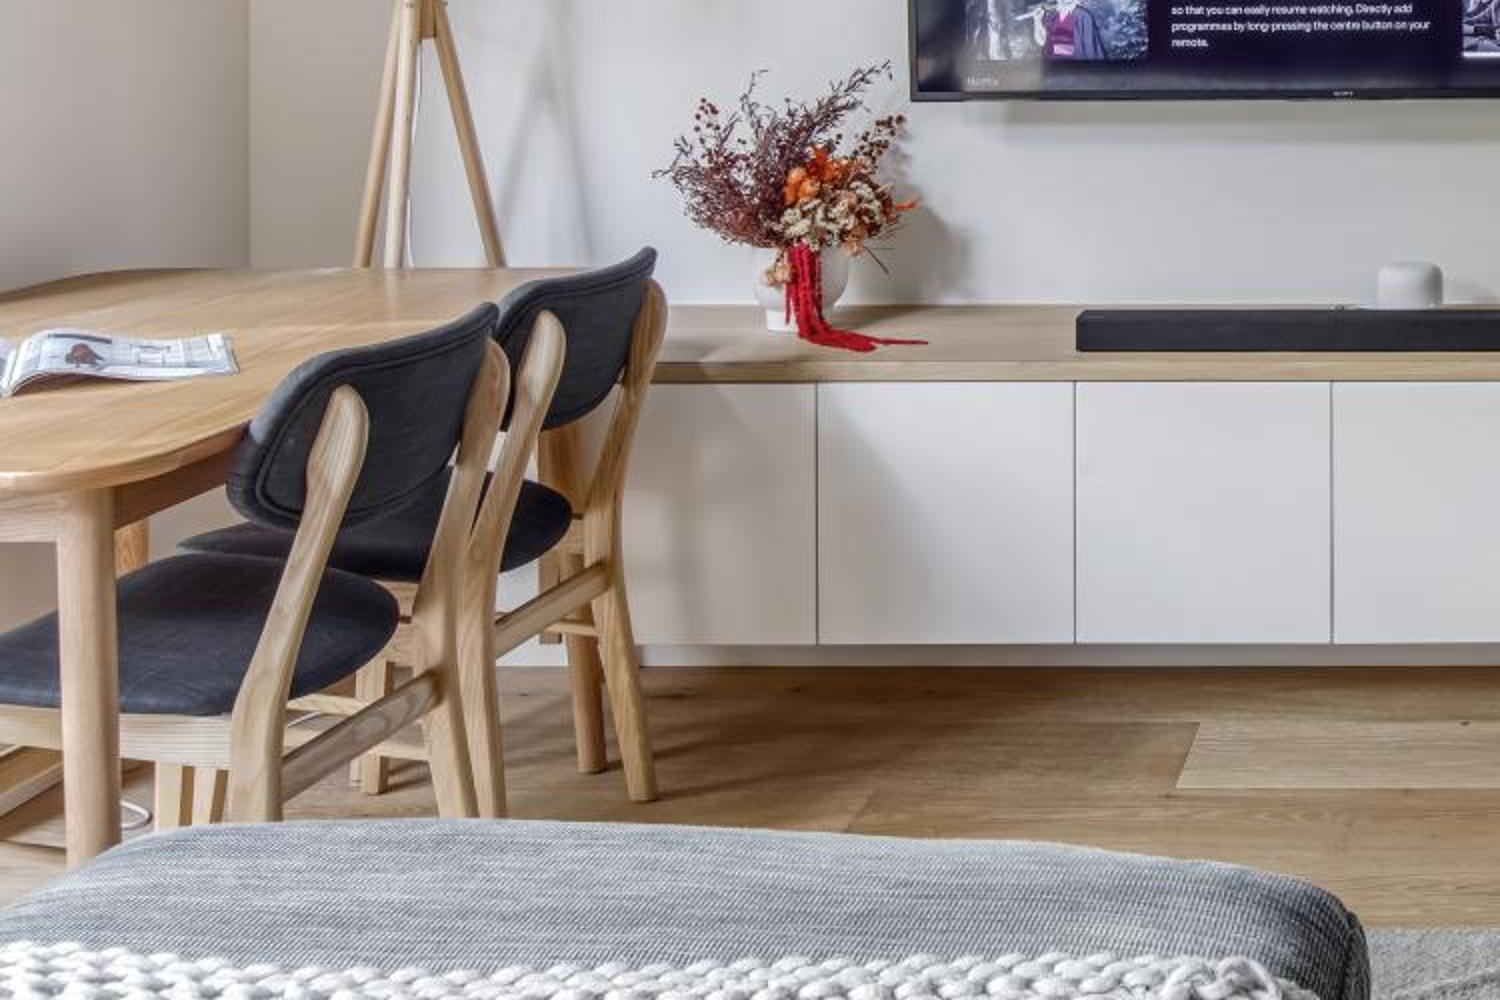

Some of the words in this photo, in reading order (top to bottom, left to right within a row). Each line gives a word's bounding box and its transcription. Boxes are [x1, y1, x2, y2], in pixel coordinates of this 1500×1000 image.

[1171, 6, 1184, 14] so
[1185, 4, 1204, 14] that
[1205, 6, 1224, 16] you
[1225, 6, 1243, 14] can
[1243, 4, 1271, 16] easily
[1271, 6, 1307, 14] resume
[1355, 4, 1392, 16] Directly
[1394, 4, 1413, 14] add
[1171, 22, 1232, 33] programmes
[1233, 21, 1245, 33] by
[1313, 21, 1329, 31] the
[1329, 22, 1361, 31] centre
[1361, 21, 1393, 31] button
[1394, 22, 1408, 31] on
[1408, 22, 1431, 33] your
[1171, 38, 1209, 47] remote.
